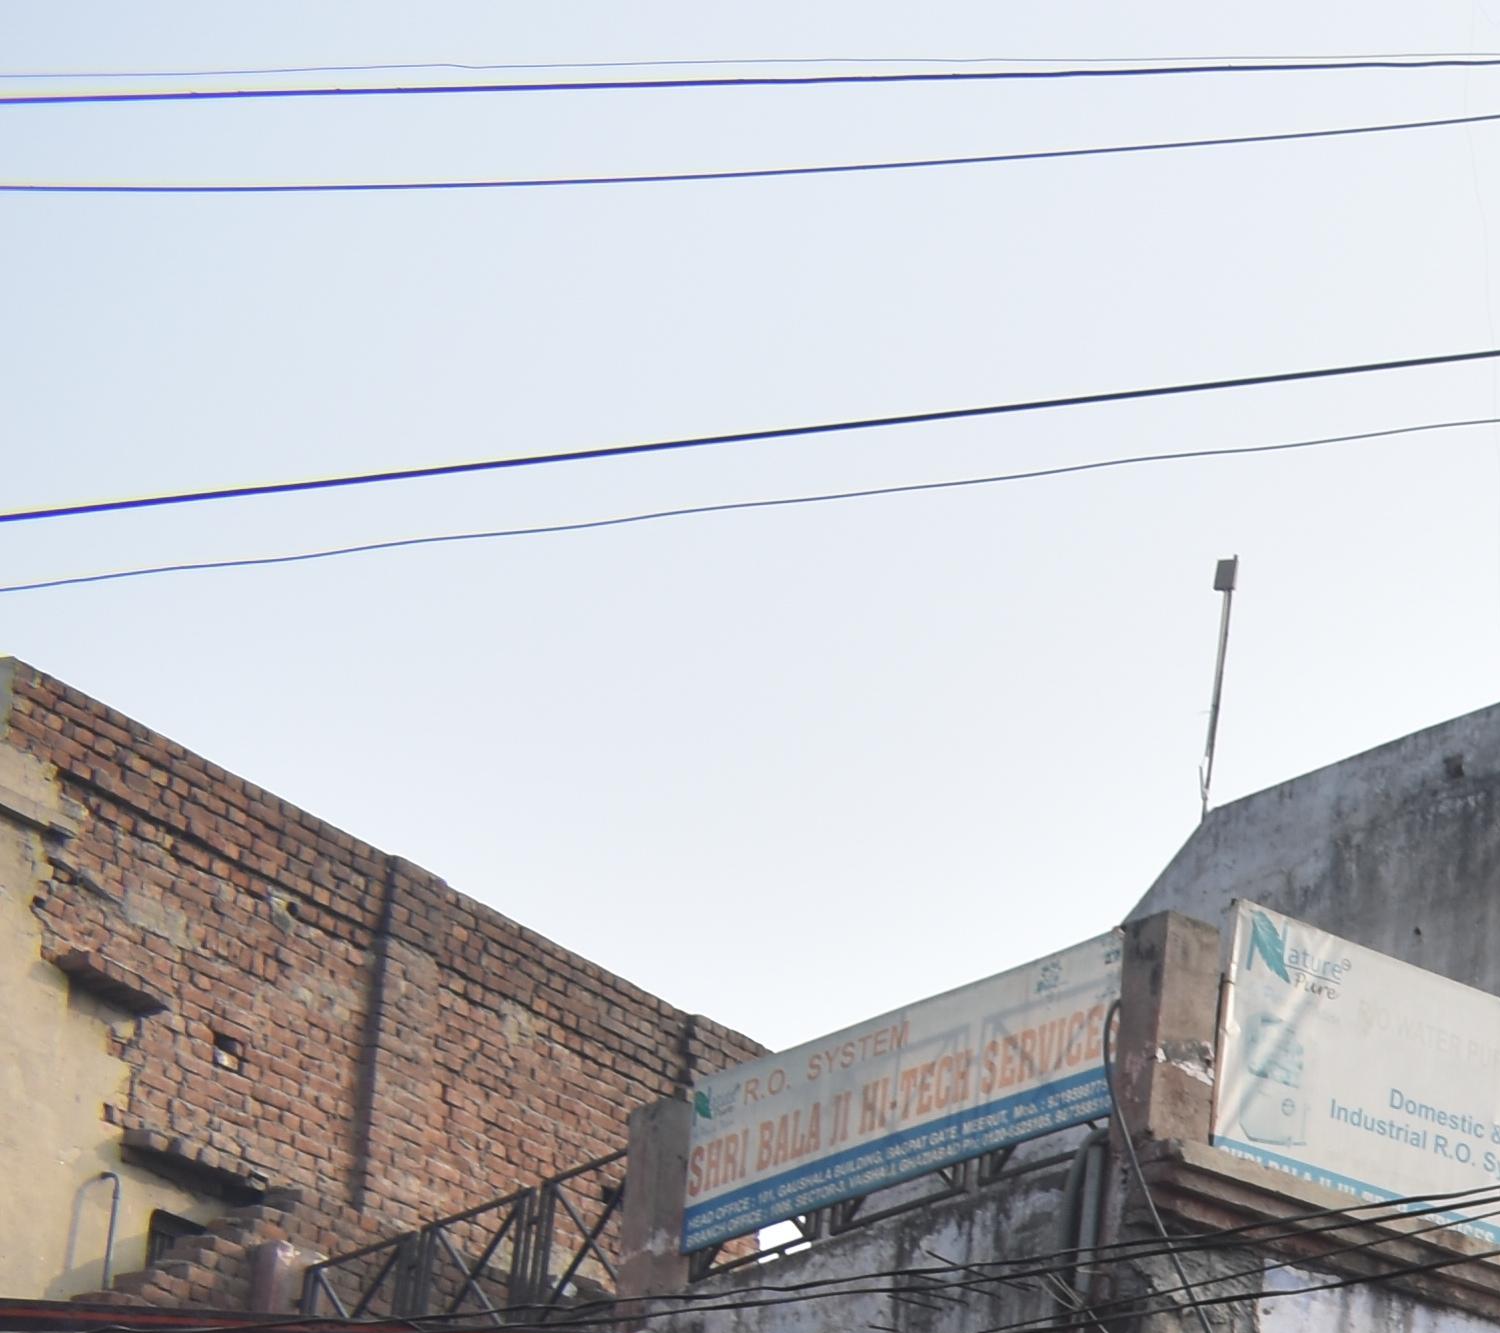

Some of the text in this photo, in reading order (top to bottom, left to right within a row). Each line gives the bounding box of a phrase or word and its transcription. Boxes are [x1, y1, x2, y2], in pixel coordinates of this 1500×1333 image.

[806, 1021, 911, 1083] SYSTEM
[1329, 1098, 1477, 1168] Industrial R.O.
[1389, 1087, 1484, 1141] Domestic
[687, 1141, 749, 1198] SHRI
[756, 1109, 822, 1174] BALA
[829, 1107, 850, 1148] JI
